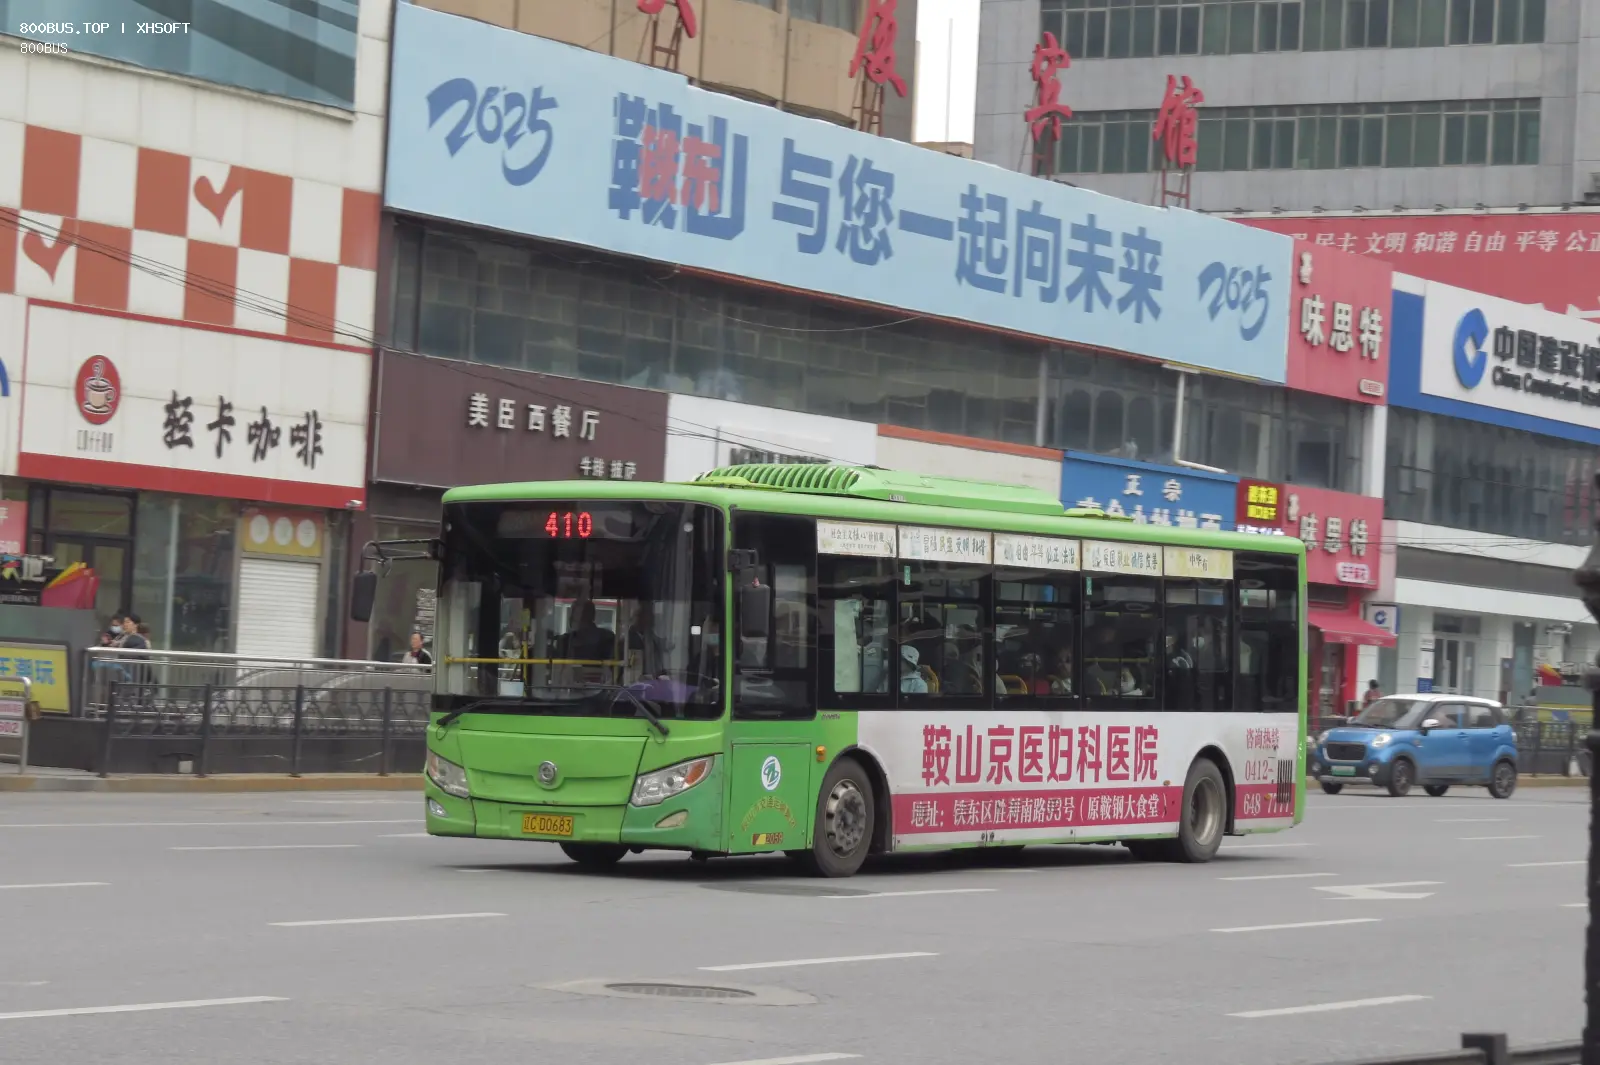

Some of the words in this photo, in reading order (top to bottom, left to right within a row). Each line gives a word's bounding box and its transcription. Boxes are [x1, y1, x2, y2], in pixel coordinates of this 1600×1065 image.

[425, 77, 559, 187] 2025
[772, 137, 1163, 324] 与您一起向未来
[1198, 261, 1272, 342] 2025
[1363, 232, 1407, 254] 文明
[1412, 232, 1458, 254] 和谐
[1463, 231, 1507, 253] 自由
[1514, 230, 1560, 253] 平等
[1301, 294, 1384, 360] 味思特
[468, 392, 600, 441] 美臣西餐厅
[1122, 474, 1184, 502] 正宗
[545, 511, 593, 538] 410
[1300, 512, 1369, 557] 味思特
[922, 724, 1159, 787] 鞍山京医妇科医院
[1246, 728, 1279, 749] 咨询热线
[1245, 760, 1274, 781] 0412-
